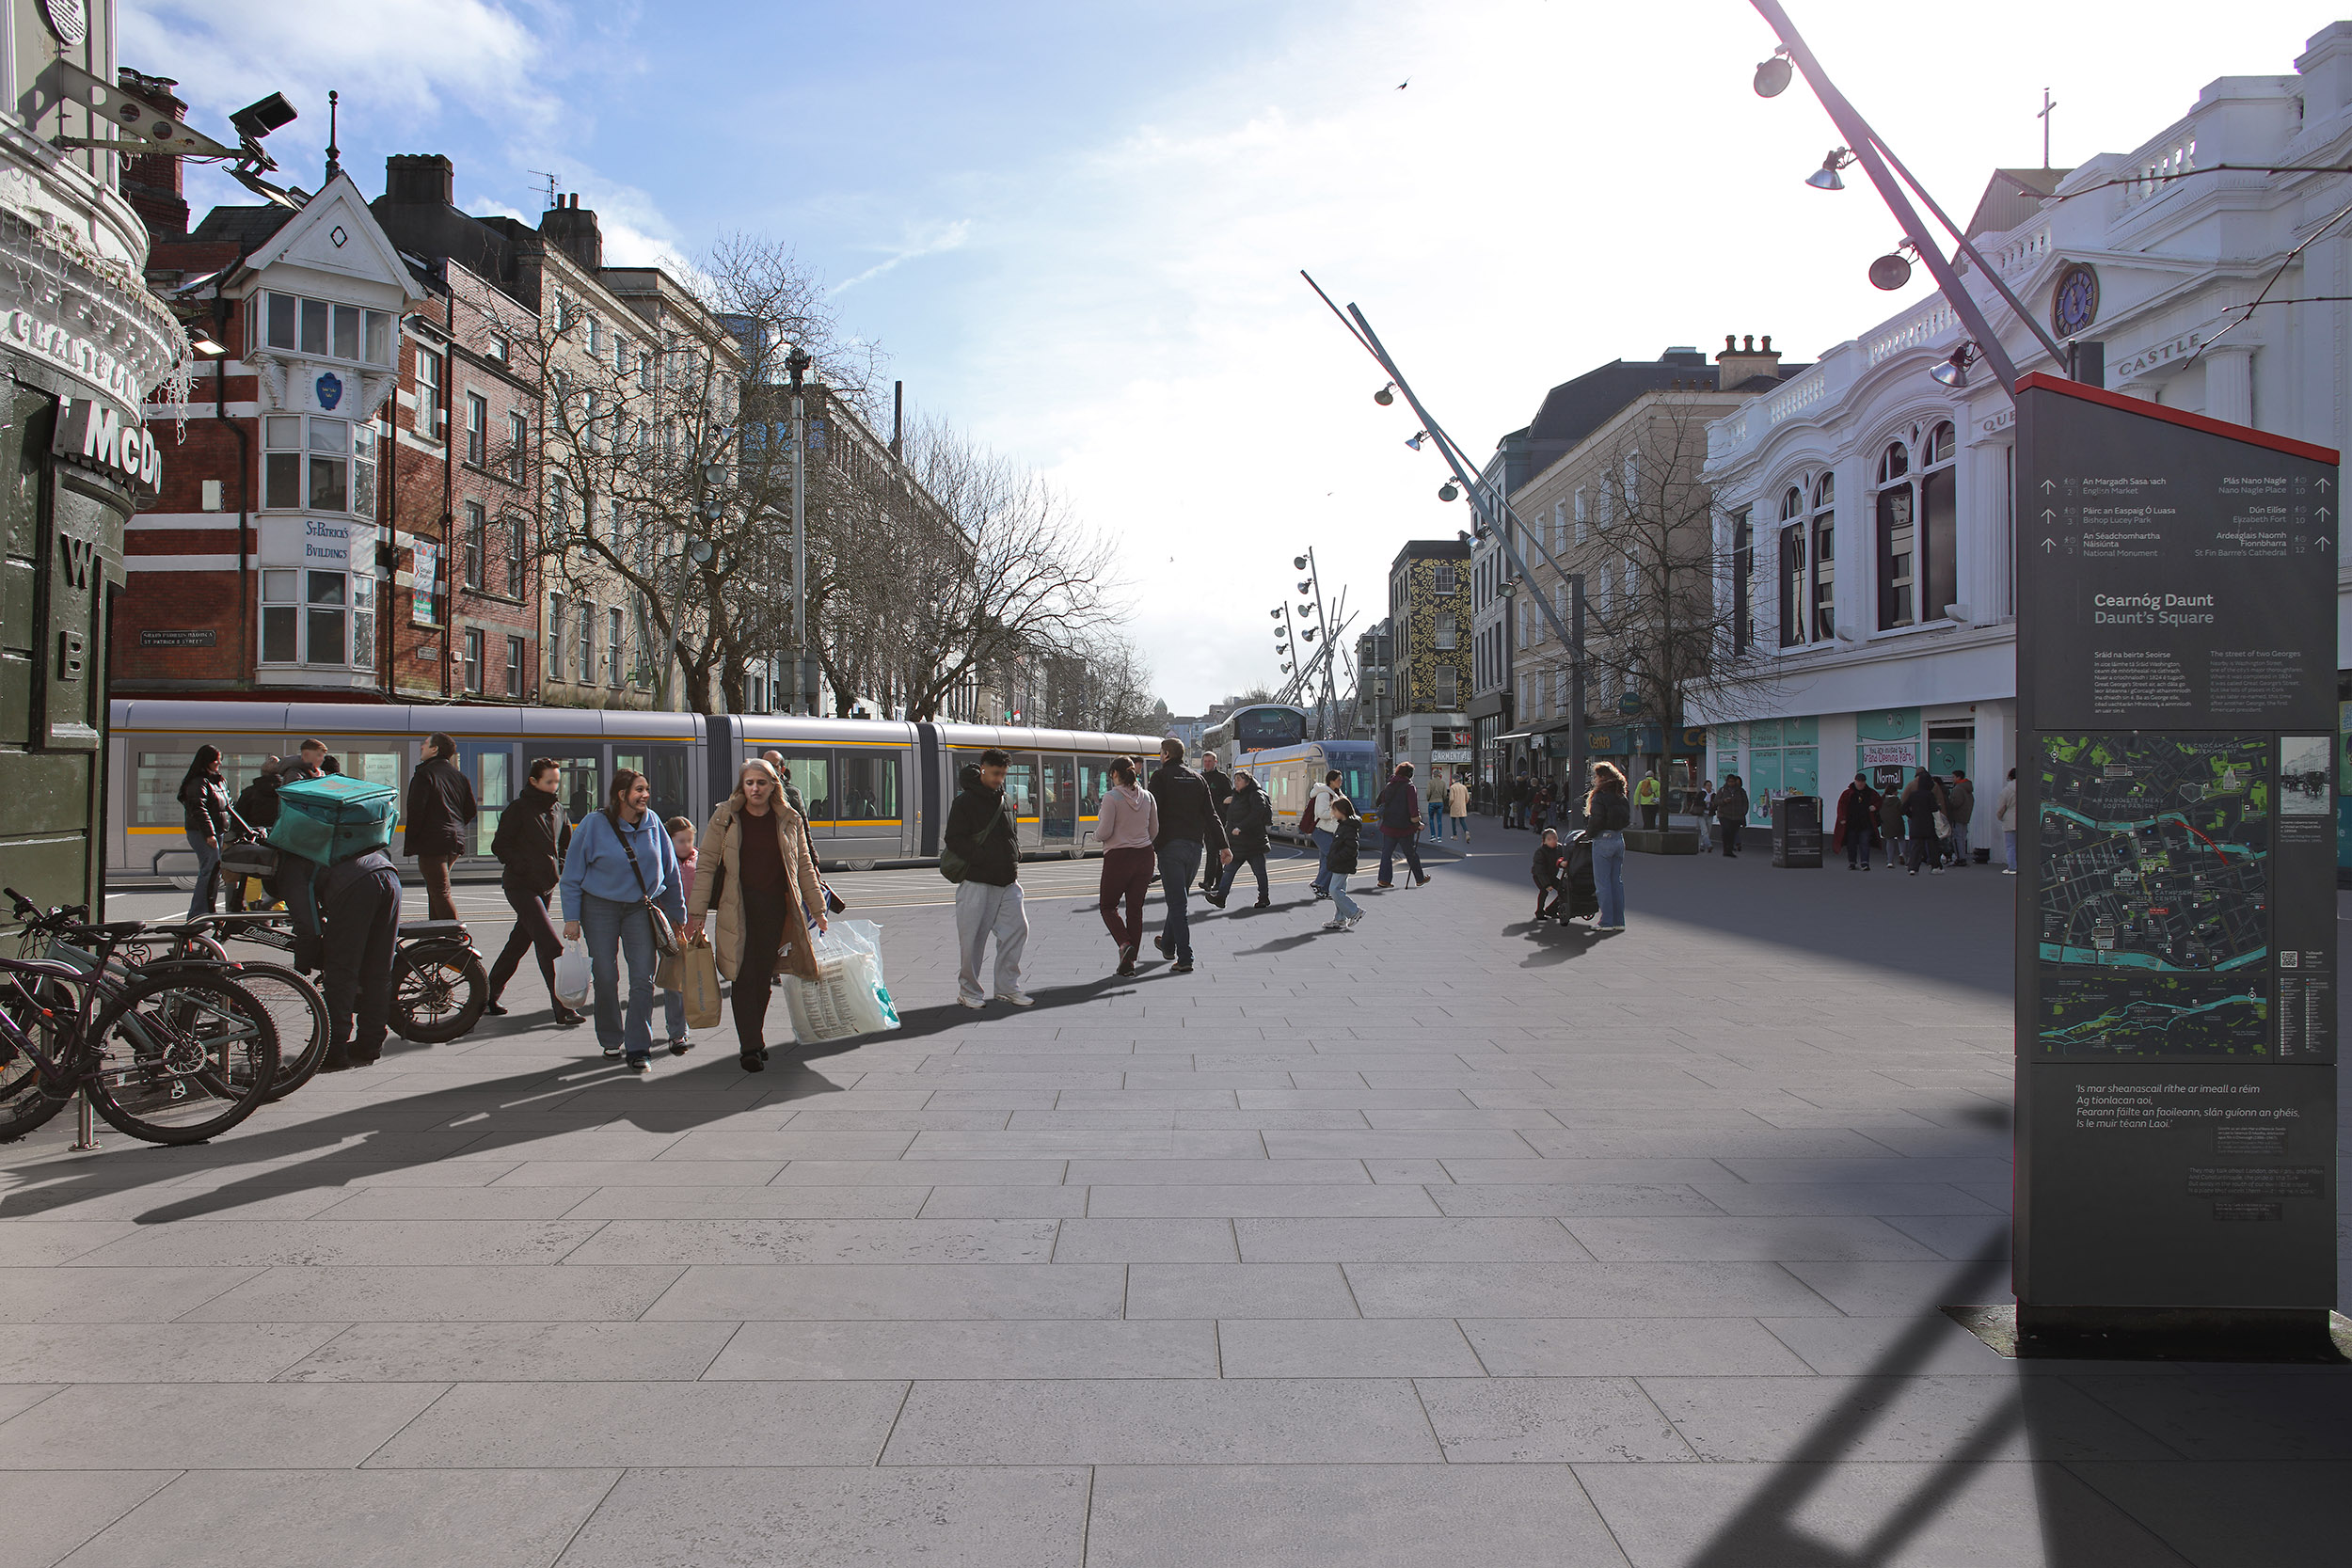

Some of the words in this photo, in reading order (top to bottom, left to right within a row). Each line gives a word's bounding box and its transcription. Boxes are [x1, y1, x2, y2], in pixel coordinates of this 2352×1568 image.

[2119, 333, 2201, 376] CASTLE
[2095, 478, 2128, 486] Margadh
[2265, 477, 2286, 486] Nagle
[2083, 487, 2109, 496] English
[2115, 507, 2143, 515] Easpaig
[2145, 505, 2152, 514] Ó
[2068, 516, 2073, 525] 3
[2083, 516, 2108, 525] Bishop
[2296, 516, 2306, 525] 10
[2095, 532, 2160, 541] Séadchomhartha
[2217, 531, 2256, 541] Ardeaglais
[2258, 531, 2286, 540] Naomh
[2095, 593, 2161, 610] Cearnóg
[2166, 594, 2214, 606] Daunt
[2095, 611, 2154, 623] Daunt's
[2159, 611, 2214, 626] Square
[1588, 733, 1611, 750] Centra
[1682, 728, 1707, 747] Ce
[1432, 751, 1461, 761] GARMENT
[1878, 752, 1899, 763] Opening
[1899, 752, 1915, 763] Party
[1876, 768, 1900, 784] Normal
[2107, 1085, 2162, 1093] sheanascail
[2164, 1085, 2185, 1093] ríthe
[2200, 1085, 2228, 1093] imeall
[2239, 1085, 2260, 1093] réim
[2076, 1097, 2090, 1106] Ag
[2092, 1096, 2135, 1106] tionlacan
[2137, 1096, 2153, 1105] aoi,
[2117, 1107, 2140, 1117] fáilte
[2156, 1107, 2201, 1117] faoileann,
[2273, 1108, 2299, 1119] ghéis,
